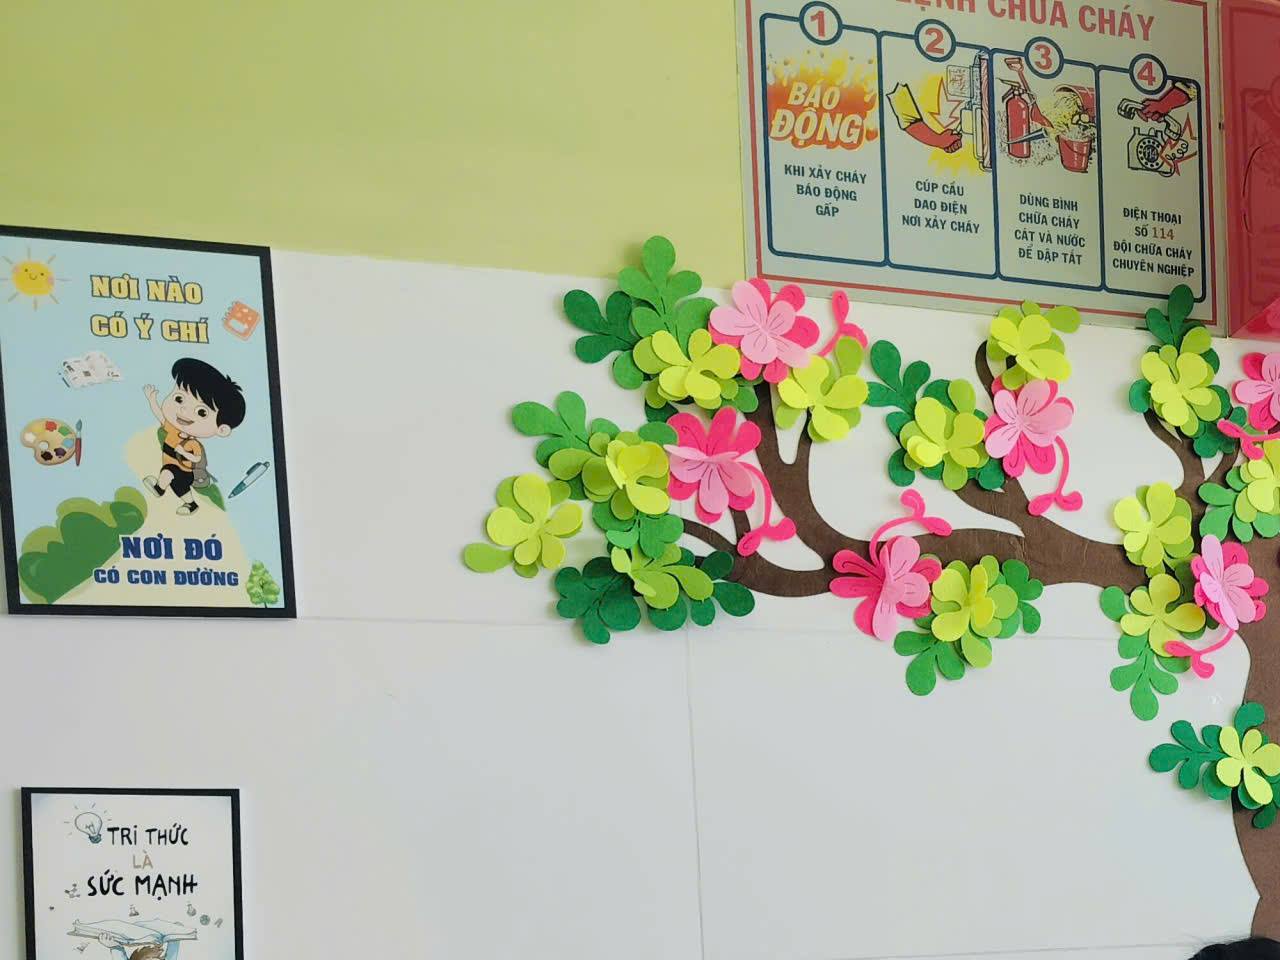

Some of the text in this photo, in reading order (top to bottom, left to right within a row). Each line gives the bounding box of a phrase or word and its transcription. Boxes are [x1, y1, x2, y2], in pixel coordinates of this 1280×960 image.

[810, 10, 825, 37] 1
[1078, 5, 1155, 41] CHÁY
[925, 27, 945, 55] 2
[1034, 44, 1053, 70] 3
[1137, 61, 1156, 86] 4
[788, 79, 841, 111] BÁO
[770, 107, 864, 146] ĐỘNG
[784, 163, 867, 184] KHI XẢY CHÁY
[796, 183, 857, 202] BÁO ĐỘNG
[915, 178, 938, 193] CÚP
[815, 202, 839, 217] GẤP
[914, 198, 967, 215] DAO ĐIỆN
[1019, 192, 1078, 211] DÙNG BÌNH
[902, 214, 980, 234] NƠI XẢY CHÁY
[1019, 211, 1080, 229] CHỮA CHÁY
[1123, 207, 1182, 226] ĐIỆN THOẠI
[1014, 227, 1086, 248] CÁT VÀ NƯỚC
[1134, 223, 1175, 240] SỐ 114
[1018, 243, 1033, 259] ĐỂ
[1037, 248, 1059, 263] DẬP
[1113, 240, 1192, 260] ĐỘI CHỮA CHÁY
[1112, 258, 1194, 278] CHUYÊN NGHIỆP
[90, 273, 203, 305] NƠI NÀO
[90, 311, 210, 344] CÓ Ý CHÍ
[121, 533, 223, 560] NƠI ĐÓ
[94, 566, 239, 586] CÓ CON ĐƯỜNG
[145, 823, 189, 845] THỨC
[132, 849, 153, 869] LÀ
[87, 869, 198, 901] SỨC MẠNH
